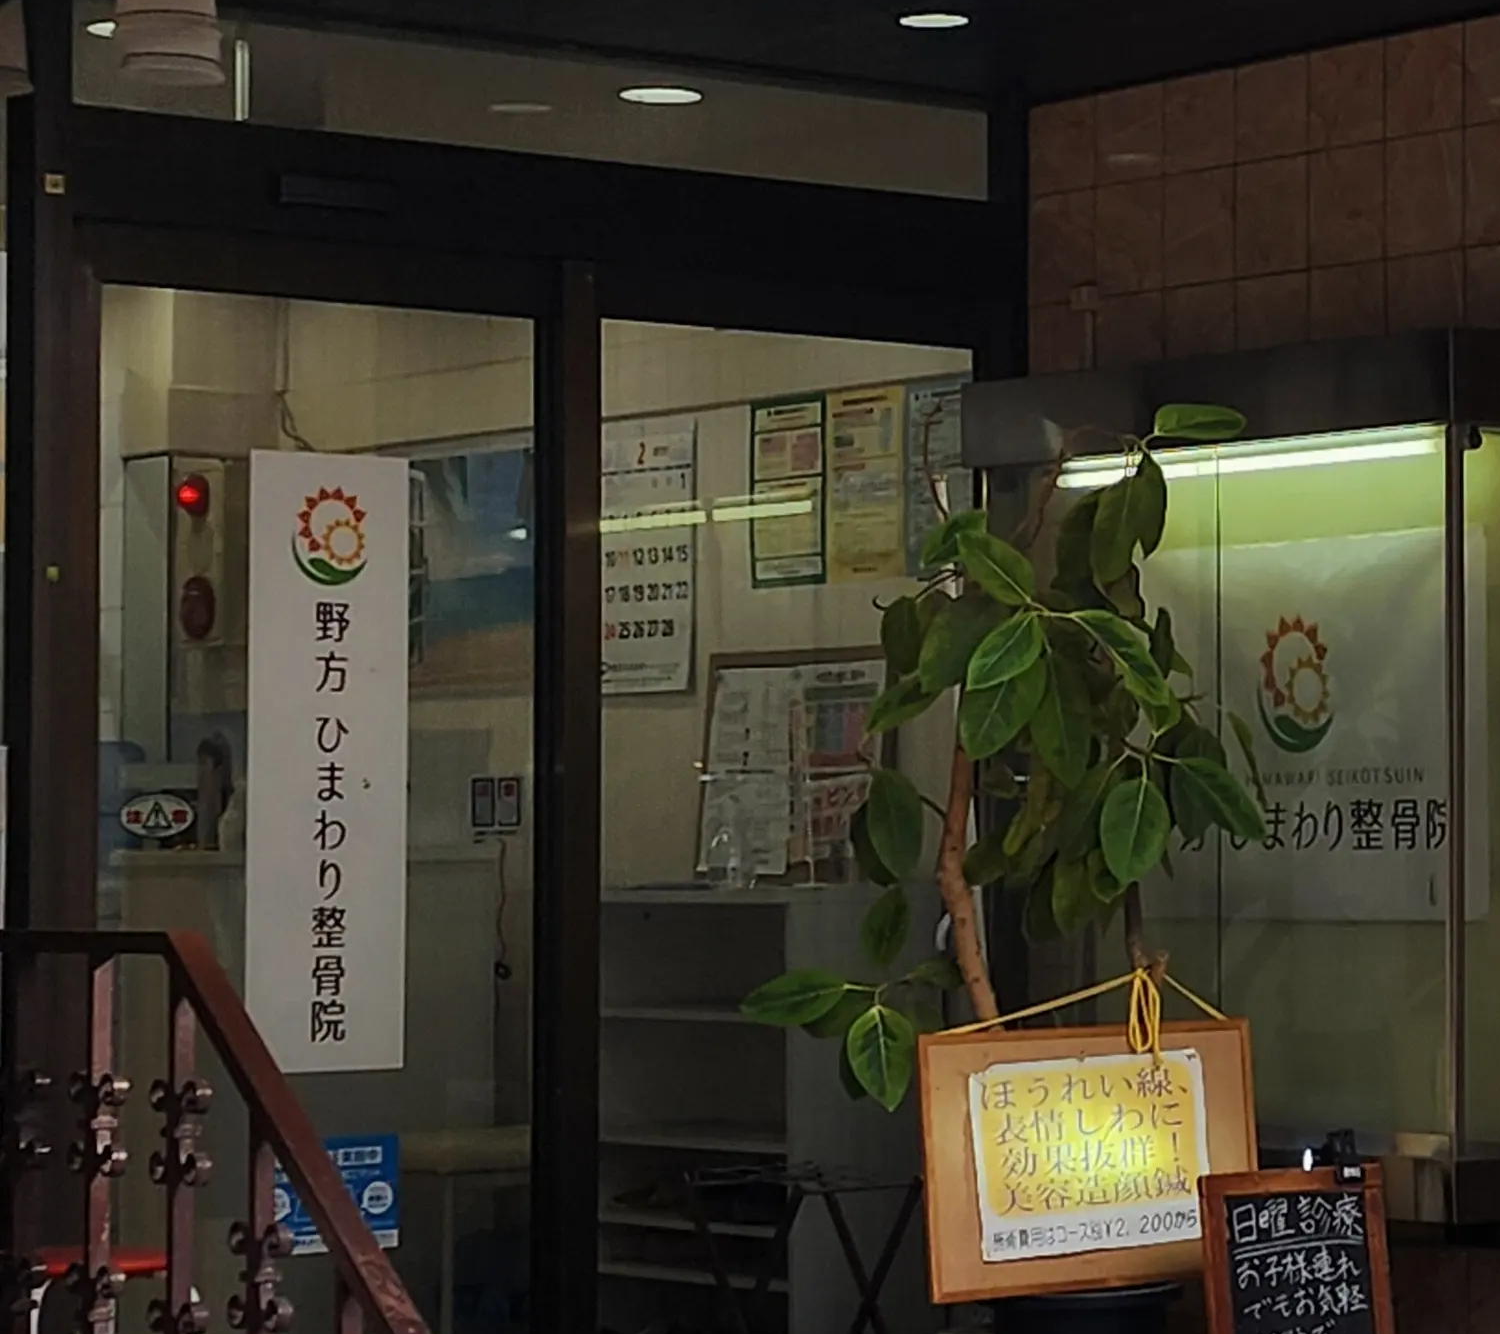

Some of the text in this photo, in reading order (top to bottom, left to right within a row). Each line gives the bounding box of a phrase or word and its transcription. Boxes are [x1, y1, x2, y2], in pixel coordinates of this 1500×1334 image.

[1236, 1244, 1362, 1289] お子様連れ
[1243, 1281, 1368, 1319] でもお気軽
